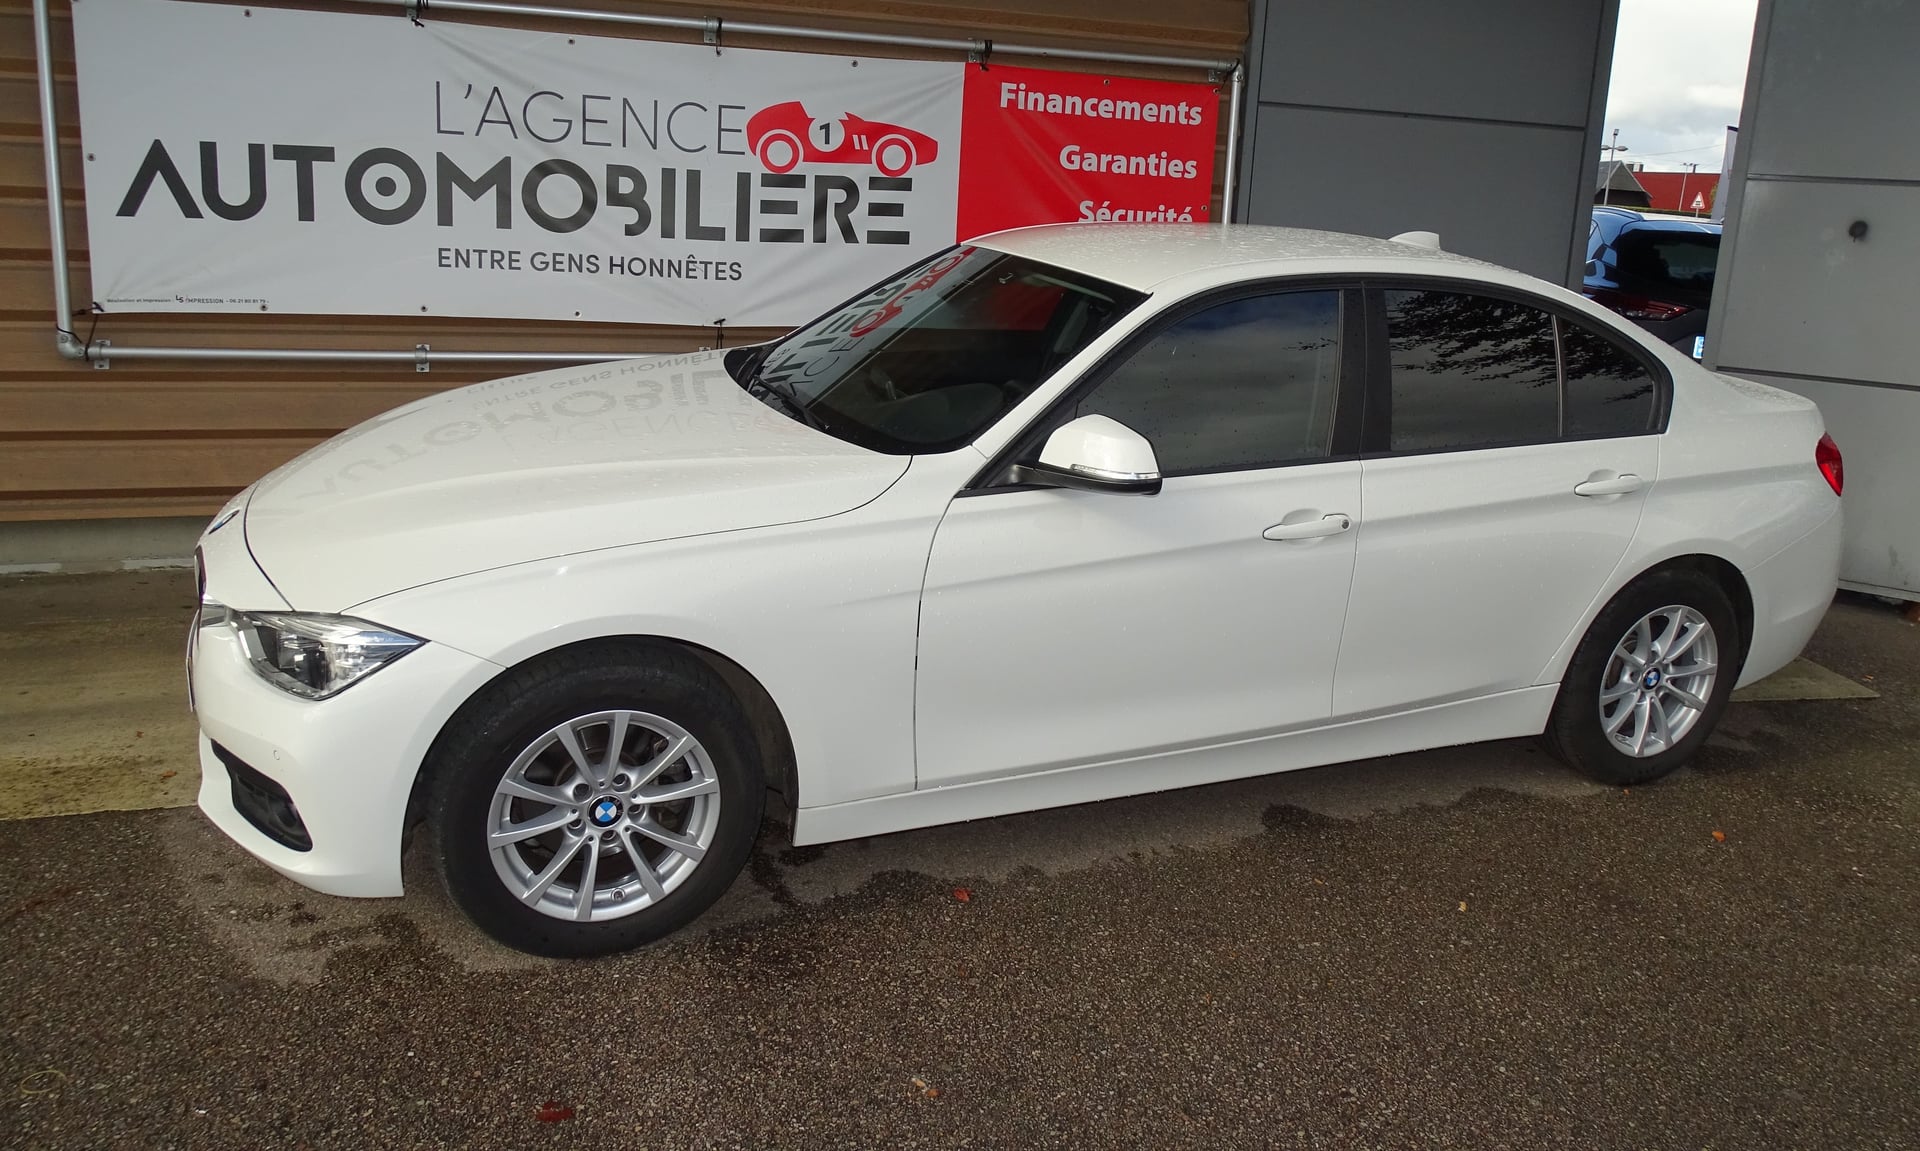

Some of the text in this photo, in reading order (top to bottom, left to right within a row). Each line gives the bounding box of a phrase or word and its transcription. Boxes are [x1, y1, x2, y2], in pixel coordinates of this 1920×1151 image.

[436, 80, 747, 157] L'AGENCE
[1000, 82, 1203, 127] Financements
[819, 122, 832, 146] 1
[1059, 143, 1198, 179] Garanties
[1078, 199, 1193, 223] Sécurité
[438, 247, 742, 281] ENTRE GENS HONNÊTES
